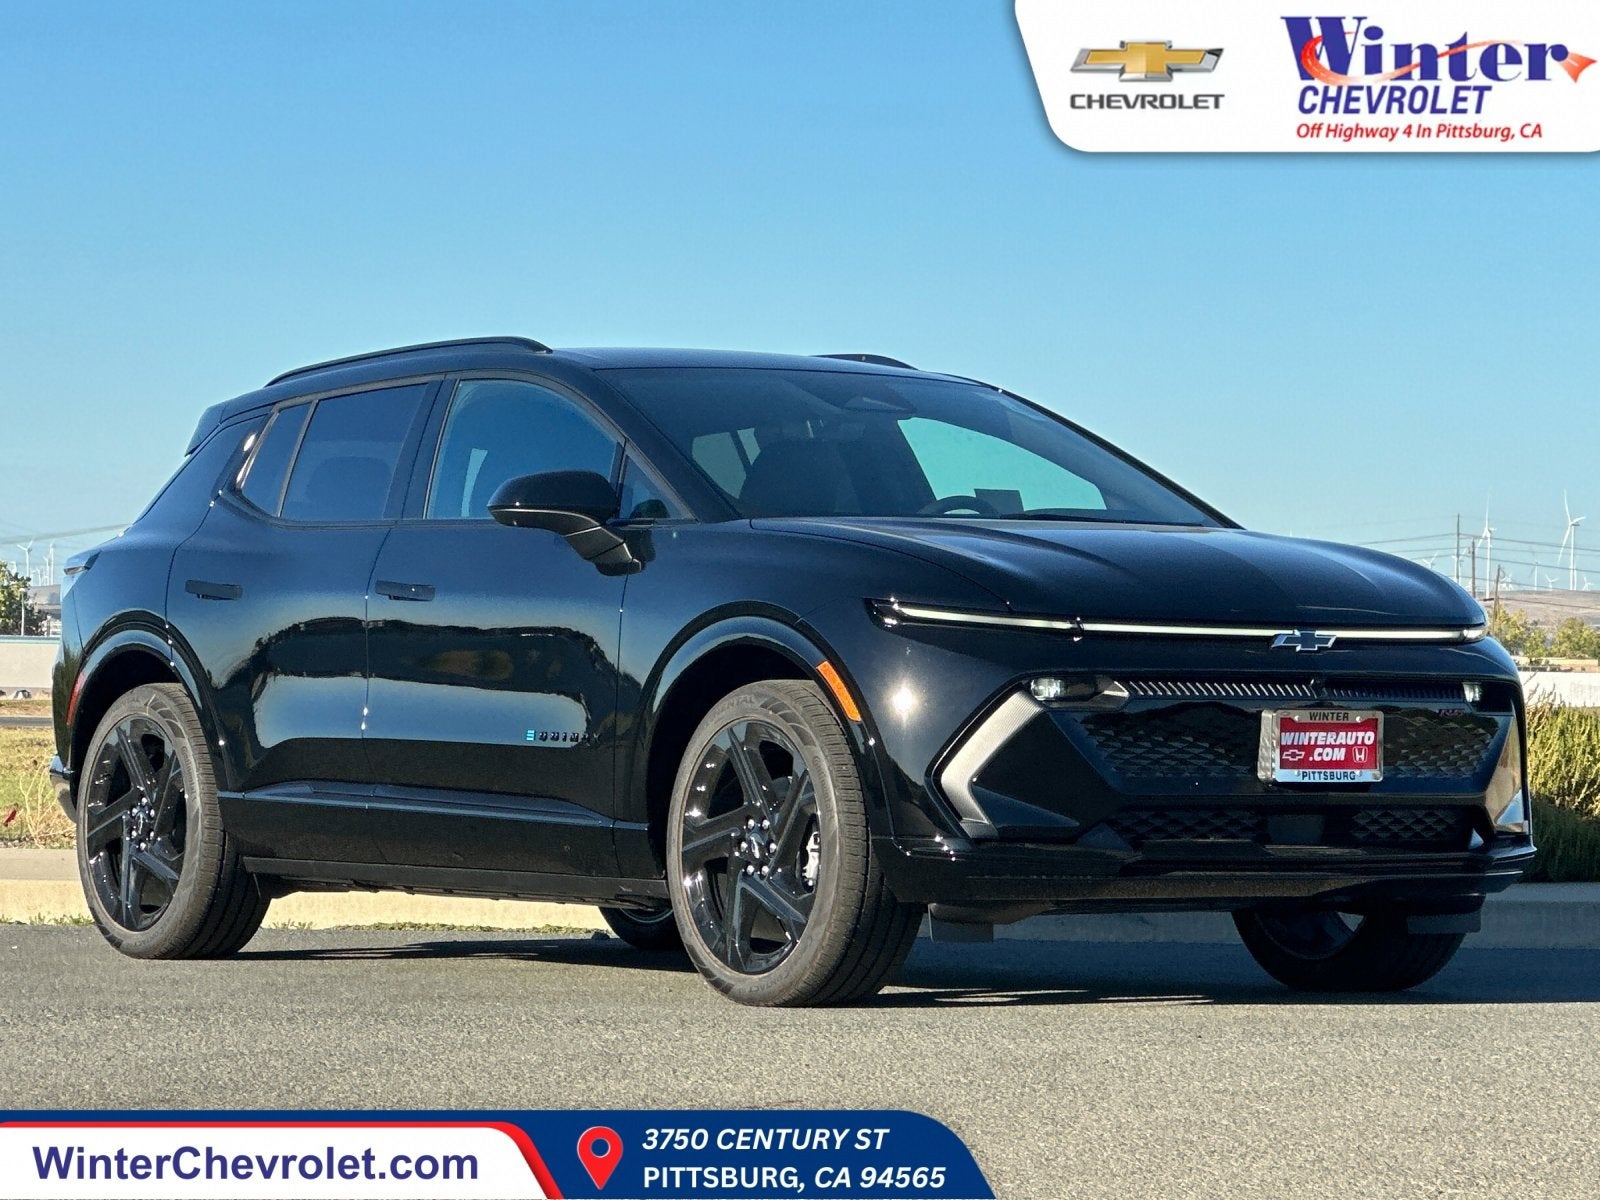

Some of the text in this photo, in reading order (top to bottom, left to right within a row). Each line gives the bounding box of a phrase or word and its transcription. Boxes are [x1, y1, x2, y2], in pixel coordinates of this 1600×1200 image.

[1309, 711, 1350, 721] WINTER
[1281, 731, 1375, 746] WINTERAUTO
[1309, 747, 1346, 761] .COM
[1301, 770, 1356, 781] PITTSBURG
